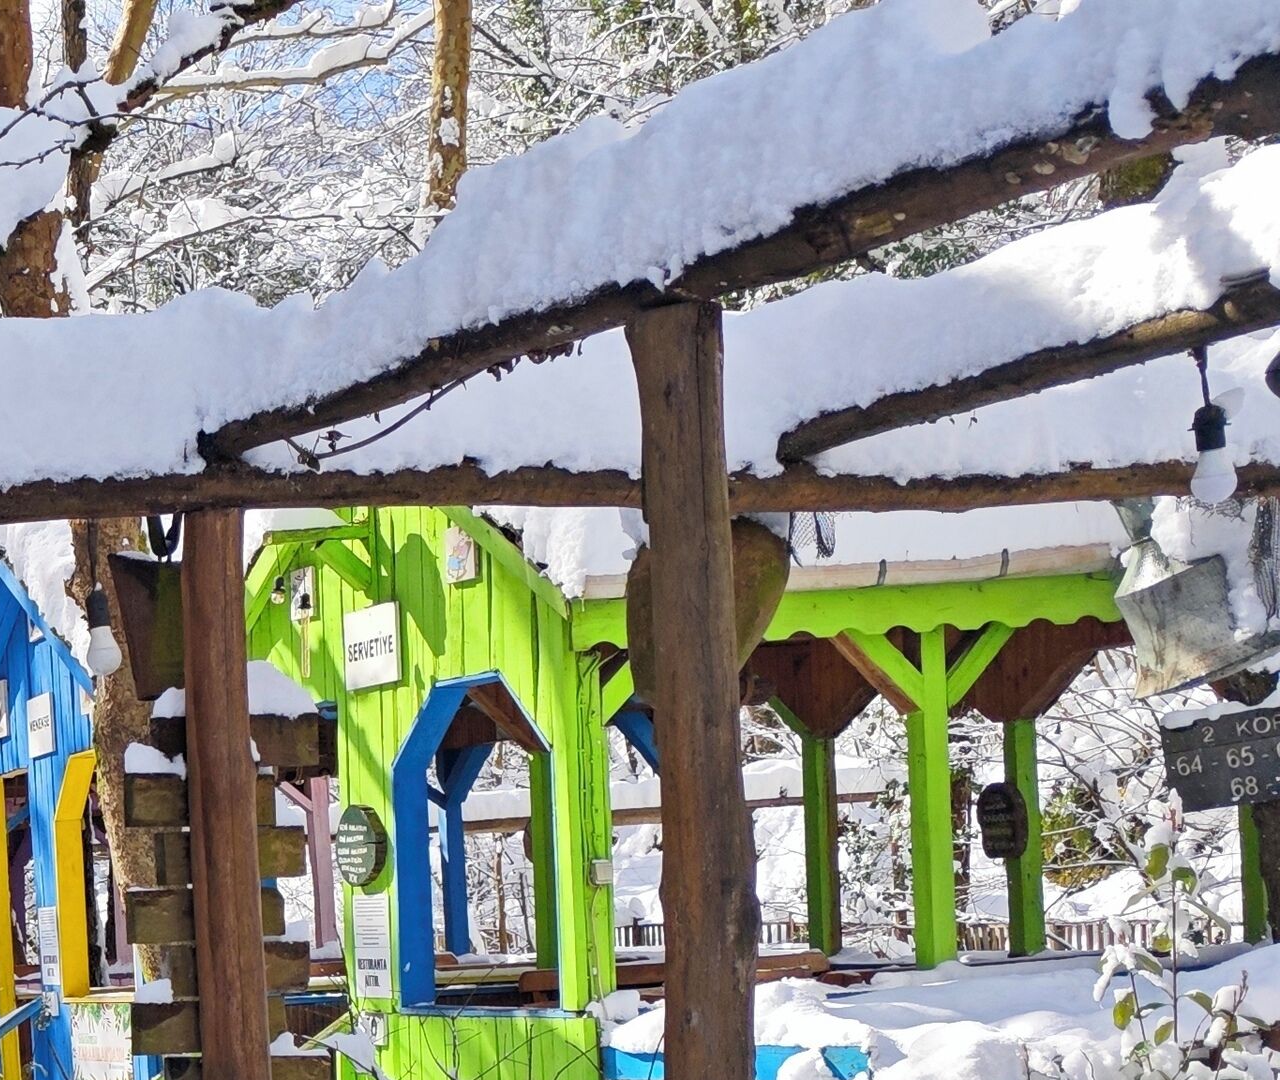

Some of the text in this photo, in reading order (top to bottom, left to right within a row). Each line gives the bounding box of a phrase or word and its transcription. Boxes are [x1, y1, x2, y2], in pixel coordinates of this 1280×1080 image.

[1201, 725, 1215, 743] 2
[1176, 754, 1202, 775] 64
[1226, 746, 1255, 769] 65
[1230, 775, 1259, 798] 68
